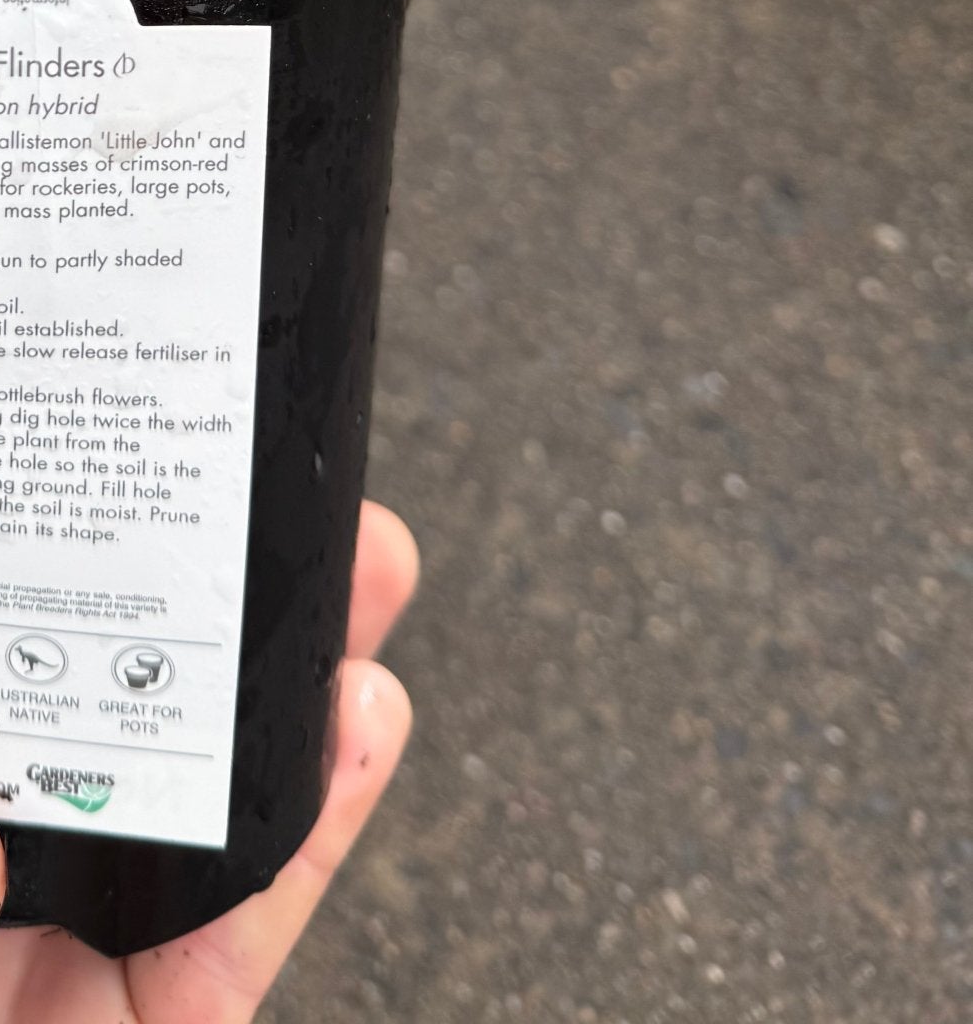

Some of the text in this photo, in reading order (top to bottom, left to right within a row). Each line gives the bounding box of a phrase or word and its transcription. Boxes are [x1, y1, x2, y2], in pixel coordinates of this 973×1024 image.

[28, 93, 100, 120] hybrid
[101, 129, 147, 150] 'Little
[152, 129, 201, 150] John'
[209, 130, 246, 149] and
[21, 160, 88, 173] masses
[95, 154, 114, 172] of
[120, 153, 228, 172] crimson-red
[0, 179, 25, 196] for
[32, 176, 122, 197] rockeries,
[131, 175, 179, 199] large
[186, 179, 230, 199] pots,
[4, 206, 51, 219] mass
[59, 198, 134, 224] planted.
[30, 254, 47, 269] to
[55, 249, 108, 274] partly
[115, 248, 183, 267] shaded
[14, 319, 124, 337] established.
[13, 341, 55, 359] slow
[62, 341, 128, 360] release
[136, 341, 208, 362] fertiliser
[215, 346, 231, 362] in
[92, 387, 163, 408] flowers.
[10, 407, 39, 430] dig
[47, 408, 86, 427] hole
[93, 413, 141, 429] twice
[148, 412, 175, 431] the
[182, 414, 232, 432] width
[13, 430, 59, 451] plant
[66, 432, 106, 451] from
[113, 434, 140, 453] the
[9, 451, 48, 470] hole
[55, 461, 75, 472] so
[82, 456, 109, 474] the
[116, 458, 146, 476] soil
[154, 461, 167, 477] is
[174, 459, 201, 479] the
[22, 478, 92, 496] ground.
[101, 480, 125, 498] Fill
[133, 481, 171, 500] hole
[32, 499, 62, 516] soil
[70, 502, 82, 517] is
[89, 505, 141, 521] moist.
[150, 506, 200, 524] Prune
[35, 521, 54, 537] its
[60, 522, 120, 545] shape.
[9, 707, 60, 724] NATIVE
[99, 699, 182, 719] GREAT FOR
[120, 719, 159, 734] POTS
[26, 762, 115, 786] GARDENERS
[40, 779, 80, 794] BEST
